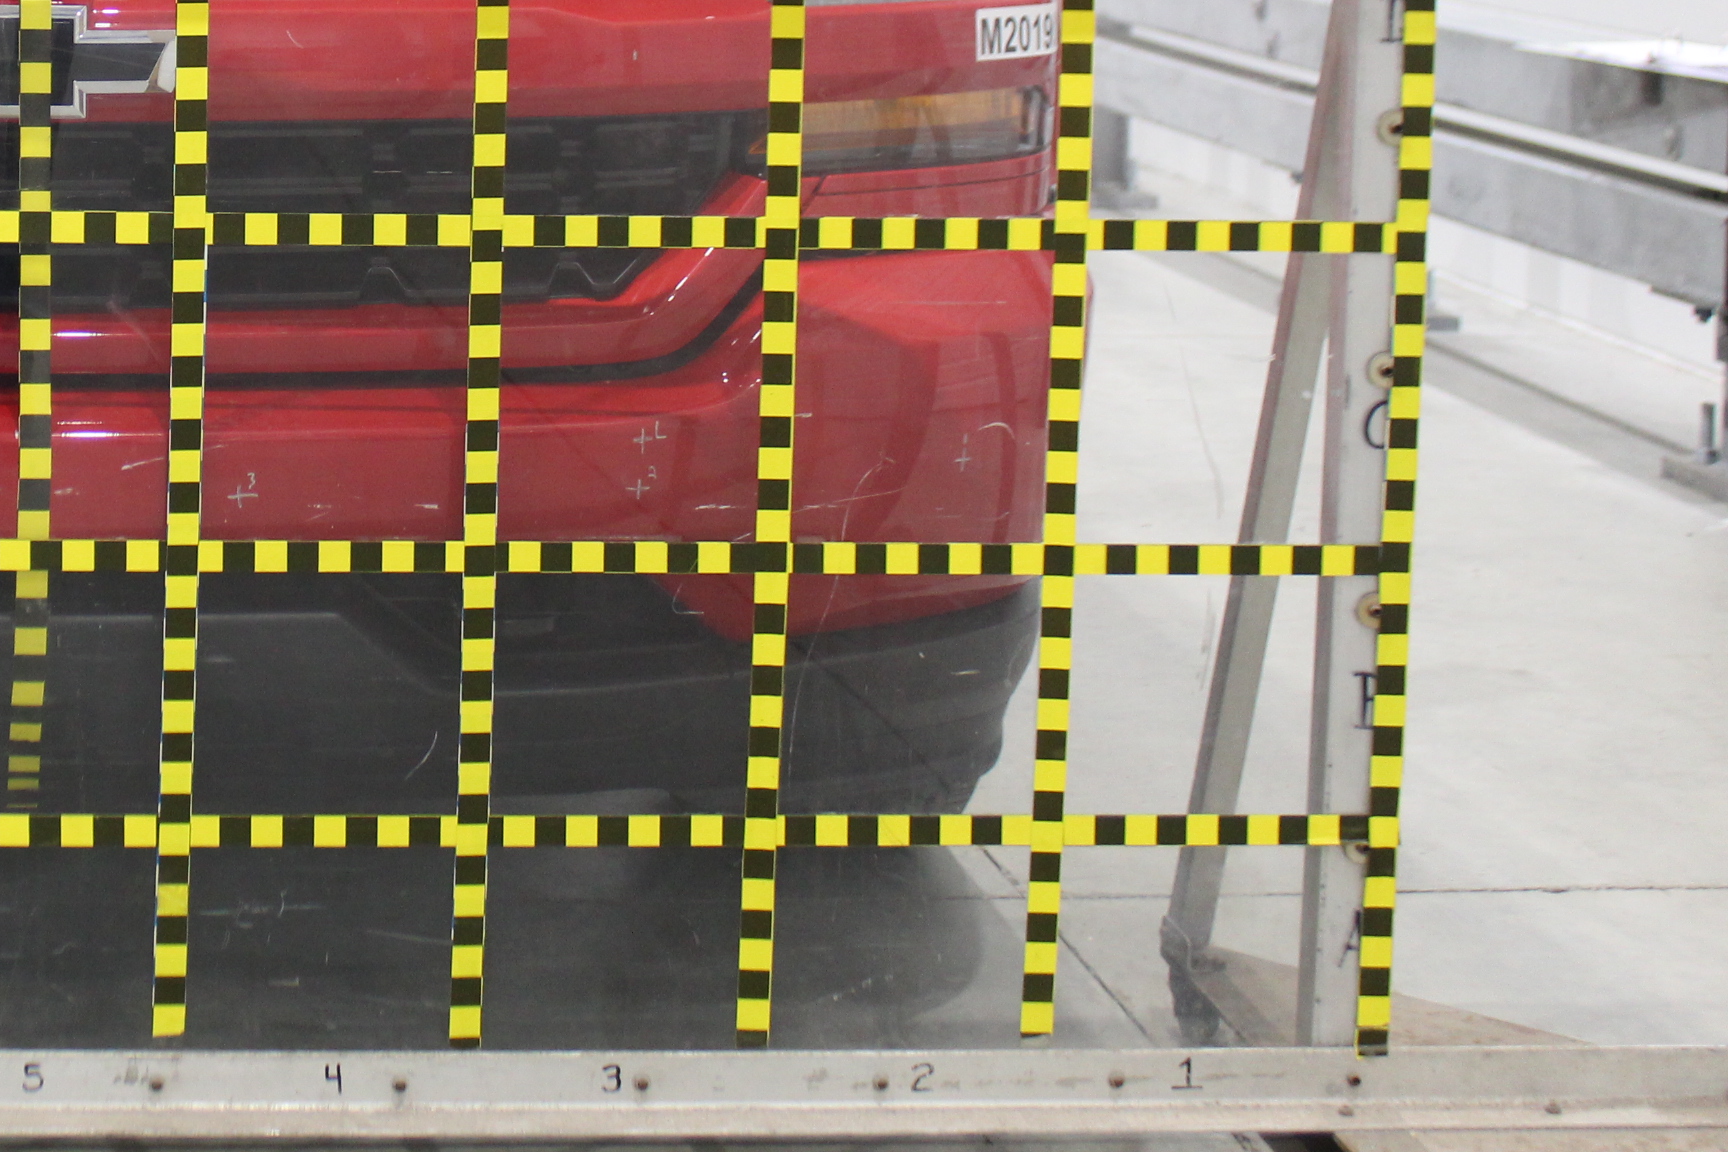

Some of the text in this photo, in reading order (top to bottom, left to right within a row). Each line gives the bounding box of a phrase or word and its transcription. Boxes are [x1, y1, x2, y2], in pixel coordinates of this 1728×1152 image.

[22, 1063, 44, 1091] 5
[324, 1063, 342, 1094] 4
[601, 1064, 622, 1092] 3
[910, 1063, 935, 1092] 2
[1172, 1056, 1202, 1090] 1
